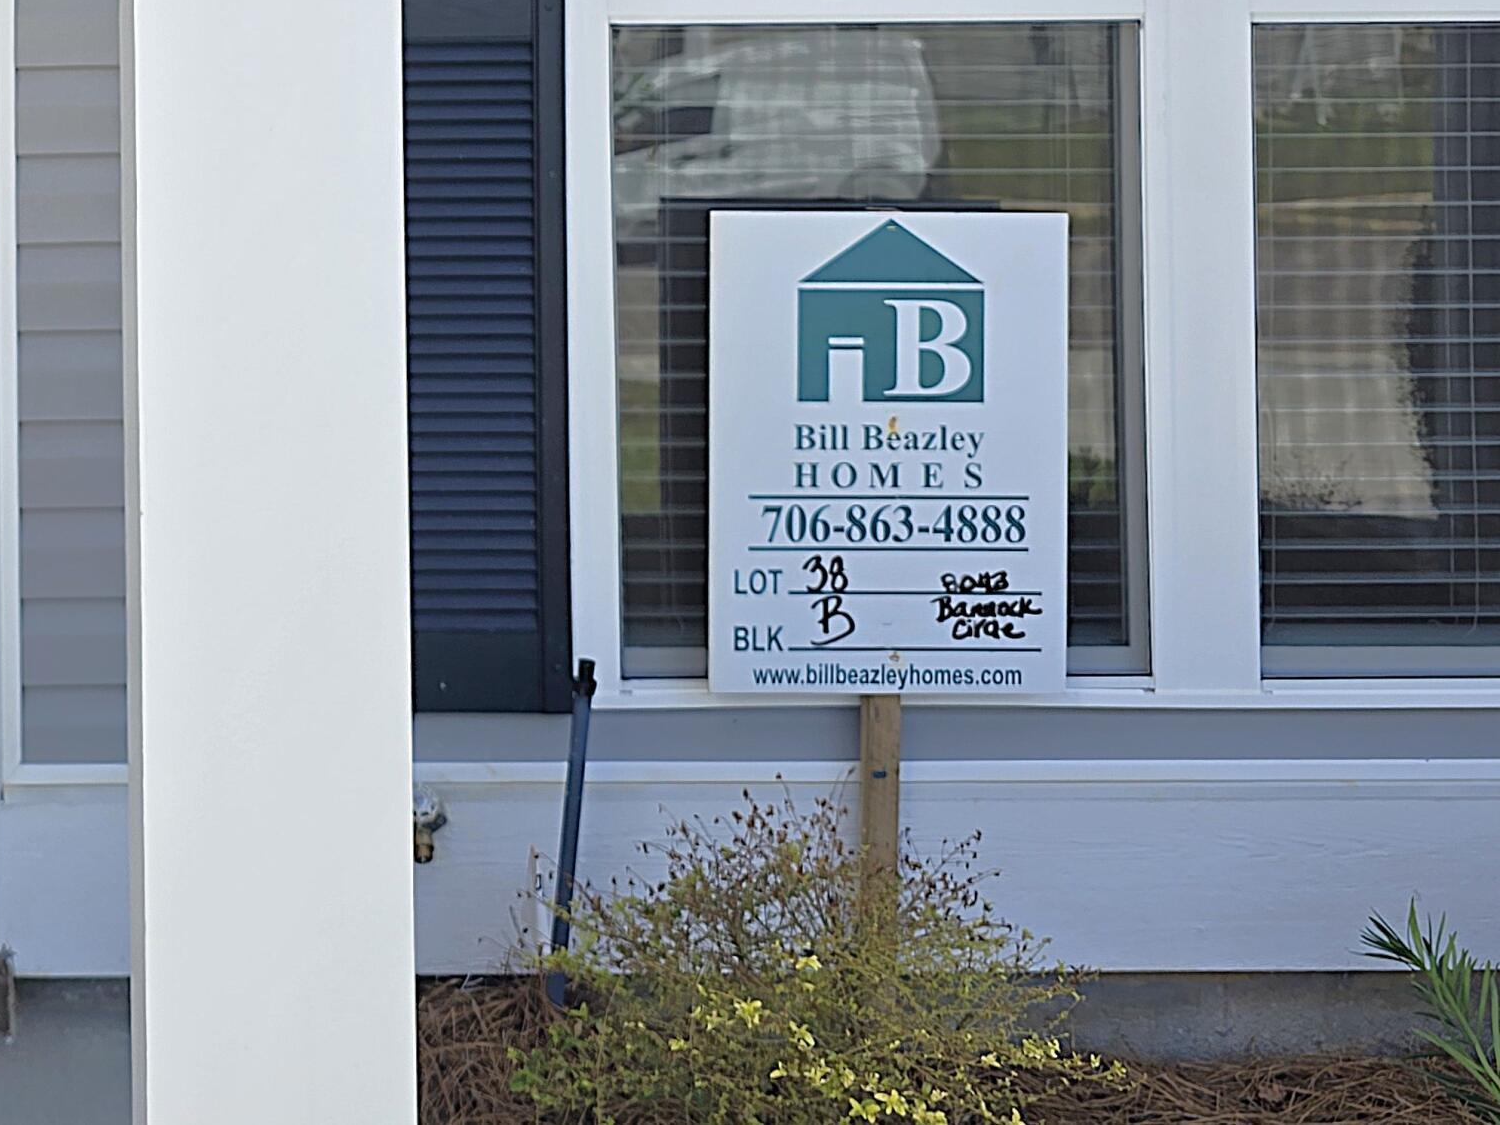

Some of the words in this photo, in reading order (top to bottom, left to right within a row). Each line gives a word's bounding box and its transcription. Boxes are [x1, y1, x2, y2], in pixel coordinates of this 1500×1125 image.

[883, 298, 973, 398] B
[794, 424, 849, 451] Bill
[862, 424, 985, 457] Beazley
[794, 462, 983, 489] HOMES
[761, 504, 1027, 544] 706-863-4888
[734, 569, 783, 595] LOT
[803, 555, 849, 594] 38
[811, 595, 856, 646] B
[734, 627, 784, 652] BLK
[753, 664, 1023, 685] www.billbeazleyhomes.com
